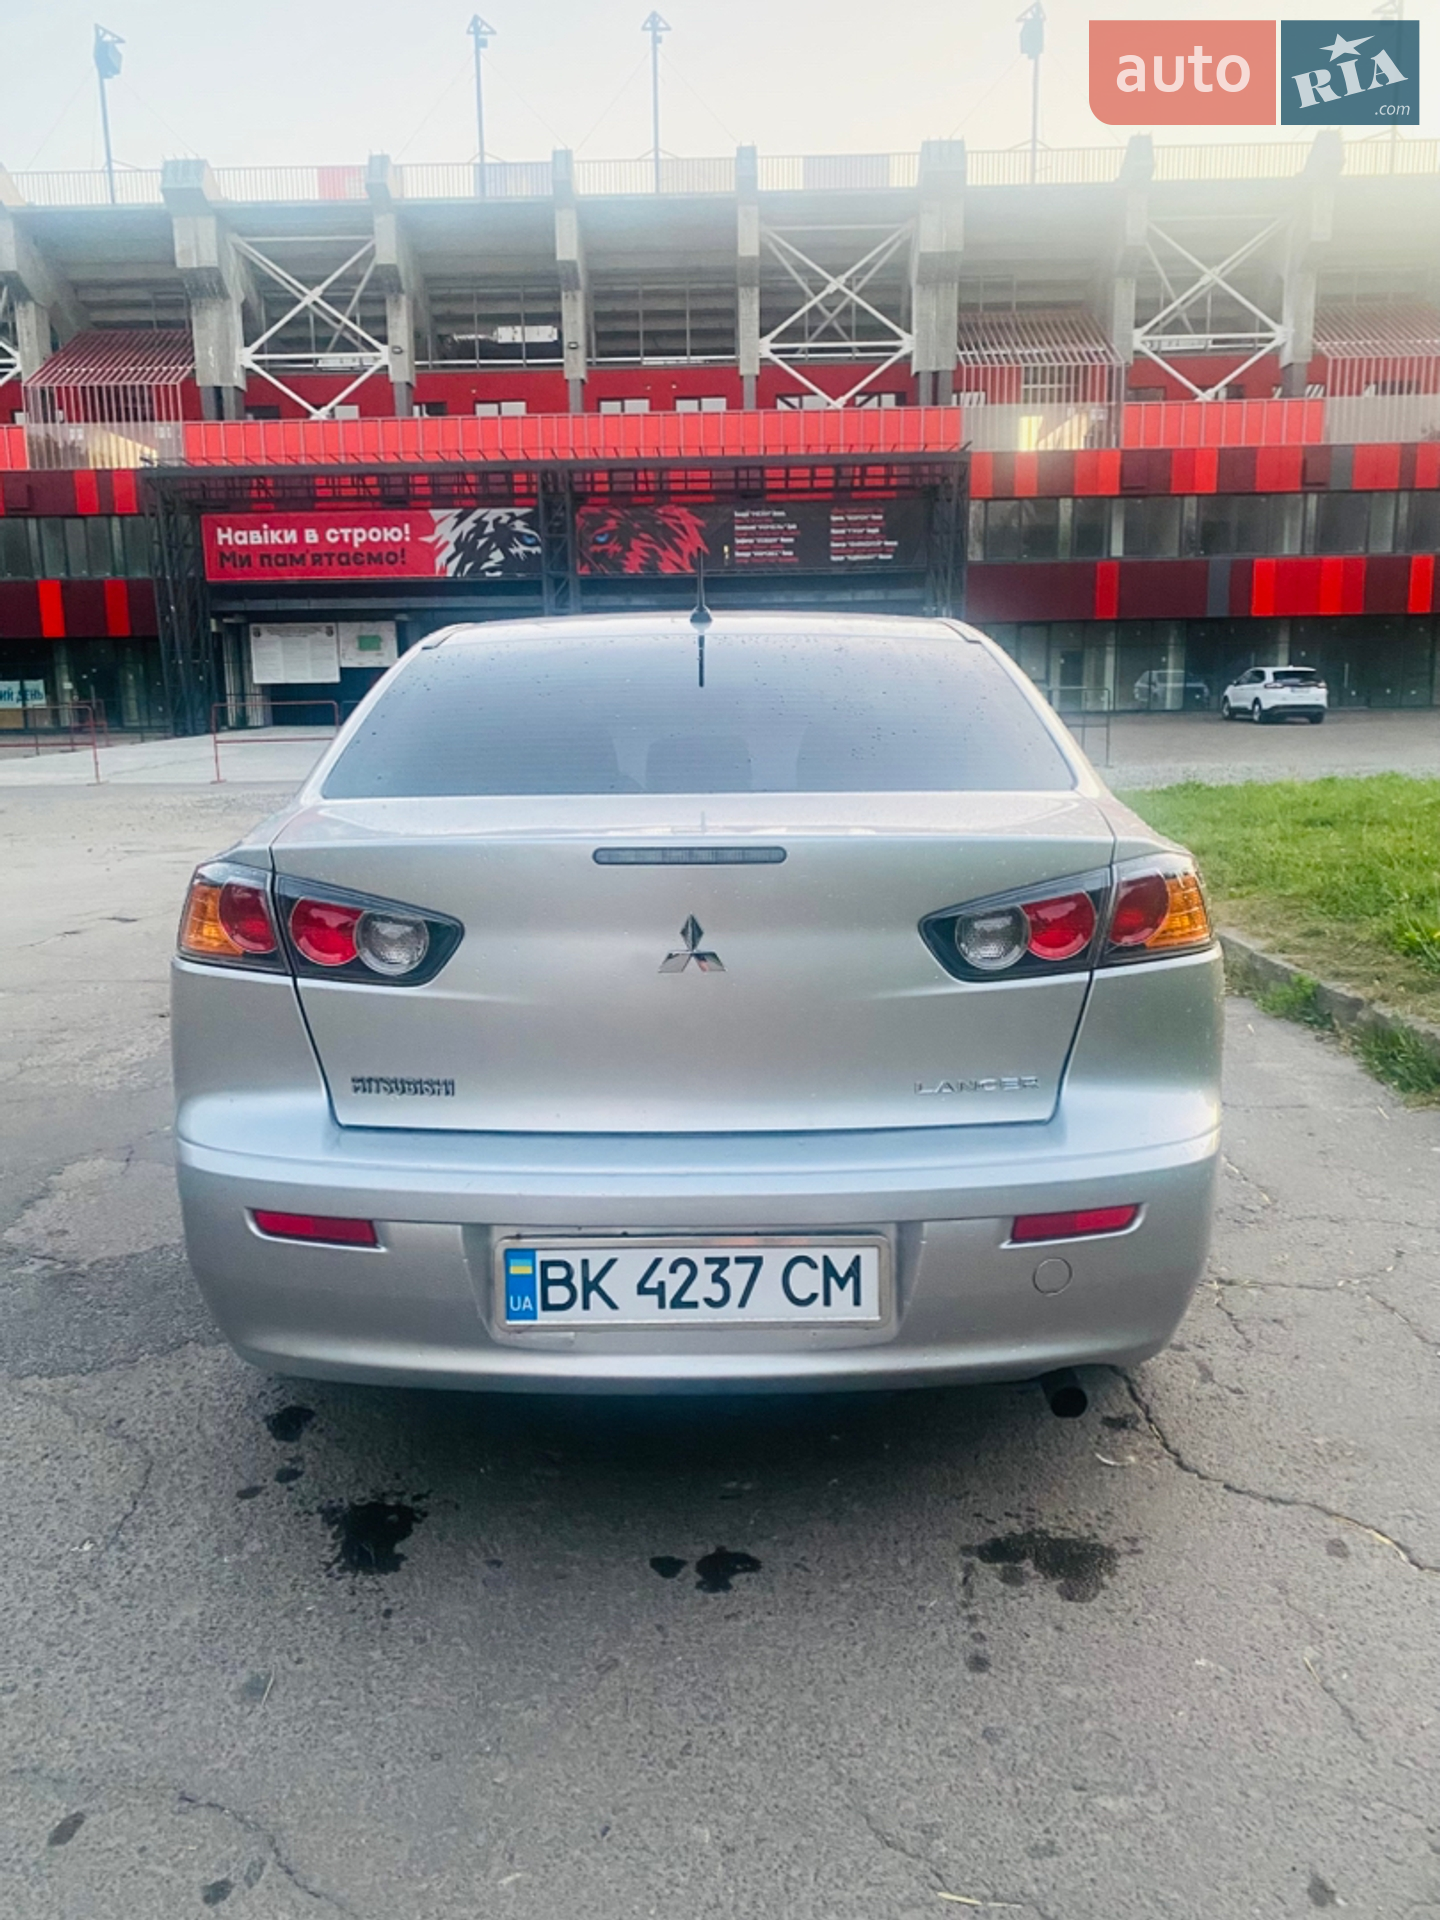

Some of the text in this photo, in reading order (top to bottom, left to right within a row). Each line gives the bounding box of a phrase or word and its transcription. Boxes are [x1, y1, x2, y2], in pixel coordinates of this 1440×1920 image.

[216, 523, 411, 548] Навіки в строю!
[219, 548, 407, 569] Ми пам'ятаємо!
[350, 1076, 456, 1097] MITSUBISHI
[913, 1076, 1040, 1096] LANCER
[540, 1254, 863, 1312] BK 4237 CM
[509, 1295, 534, 1313] UA
